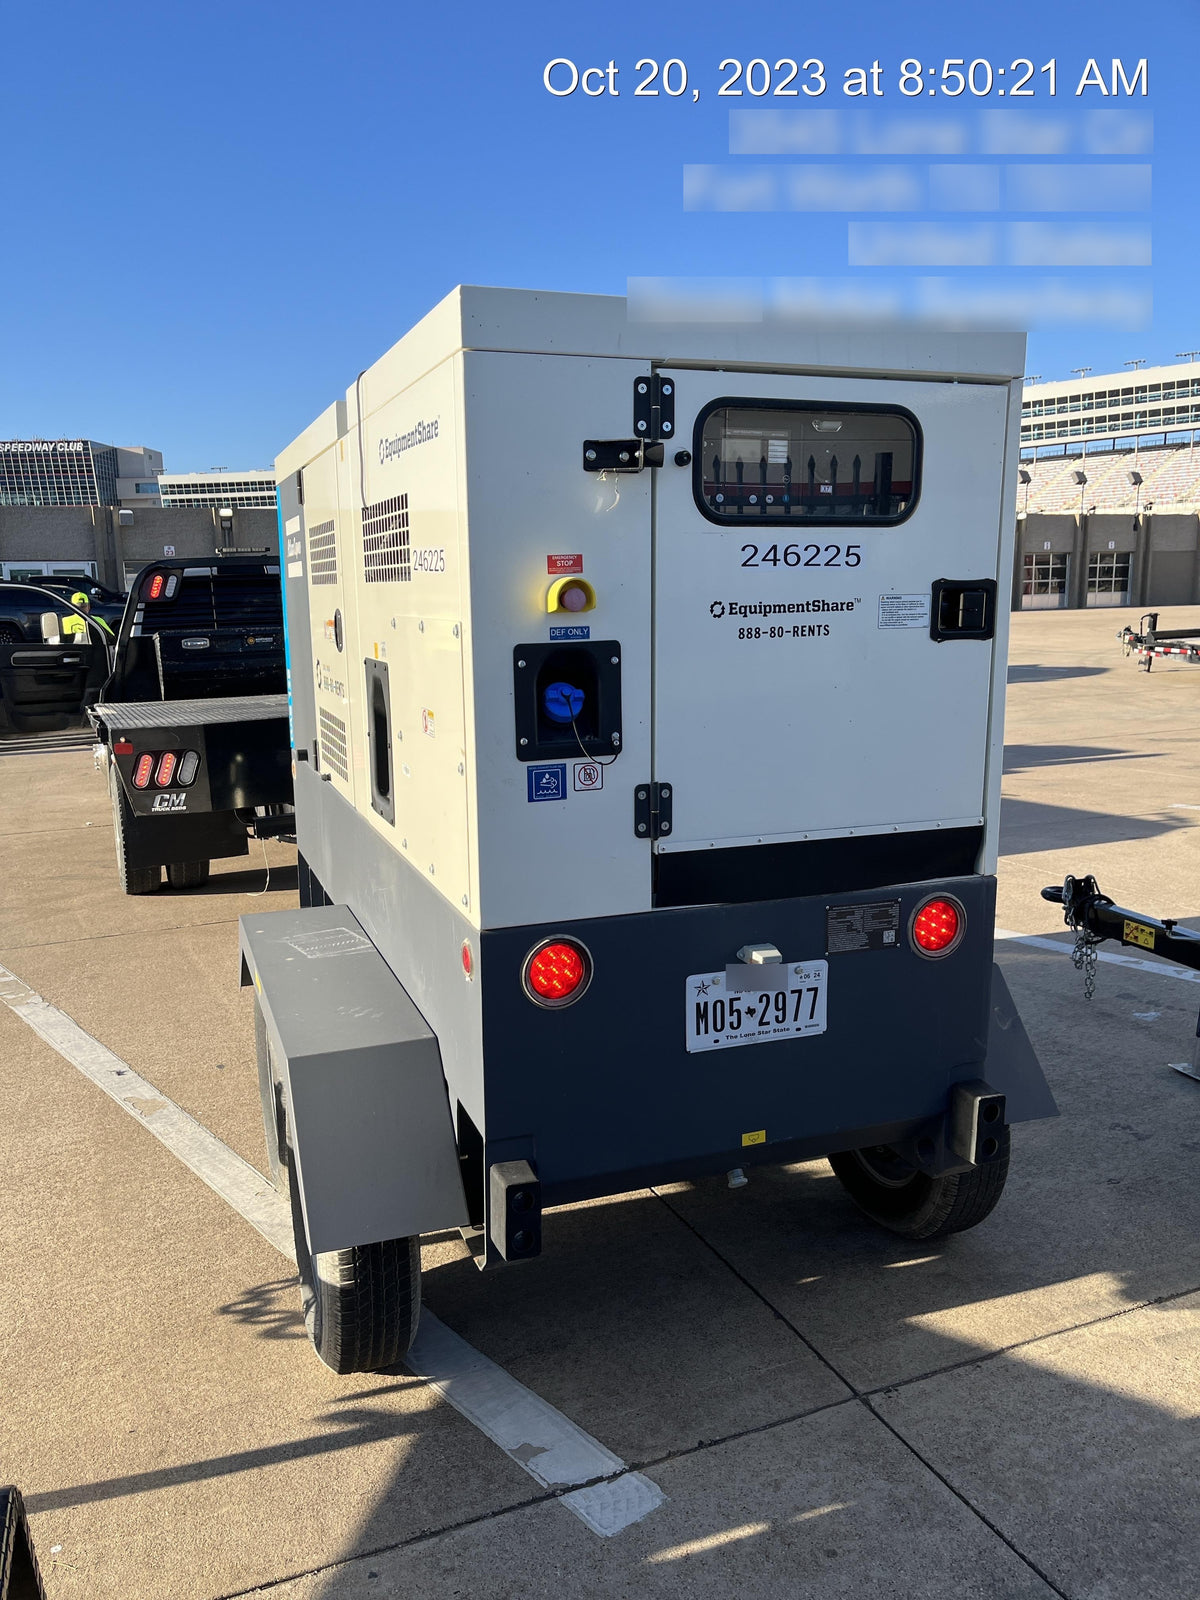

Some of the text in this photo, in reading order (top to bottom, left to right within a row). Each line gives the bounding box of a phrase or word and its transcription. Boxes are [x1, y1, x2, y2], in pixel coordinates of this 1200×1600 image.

[0, 442, 83, 452] SPEEDWAY CLUB
[384, 419, 439, 461] EquipmentShare
[413, 549, 445, 572] 246225
[741, 544, 861, 567] 246225
[728, 600, 855, 618] EquipmentShare
[550, 628, 566, 636] DEF
[738, 624, 830, 639] 888-80-RENTS
[758, 986, 819, 1027] 2977
